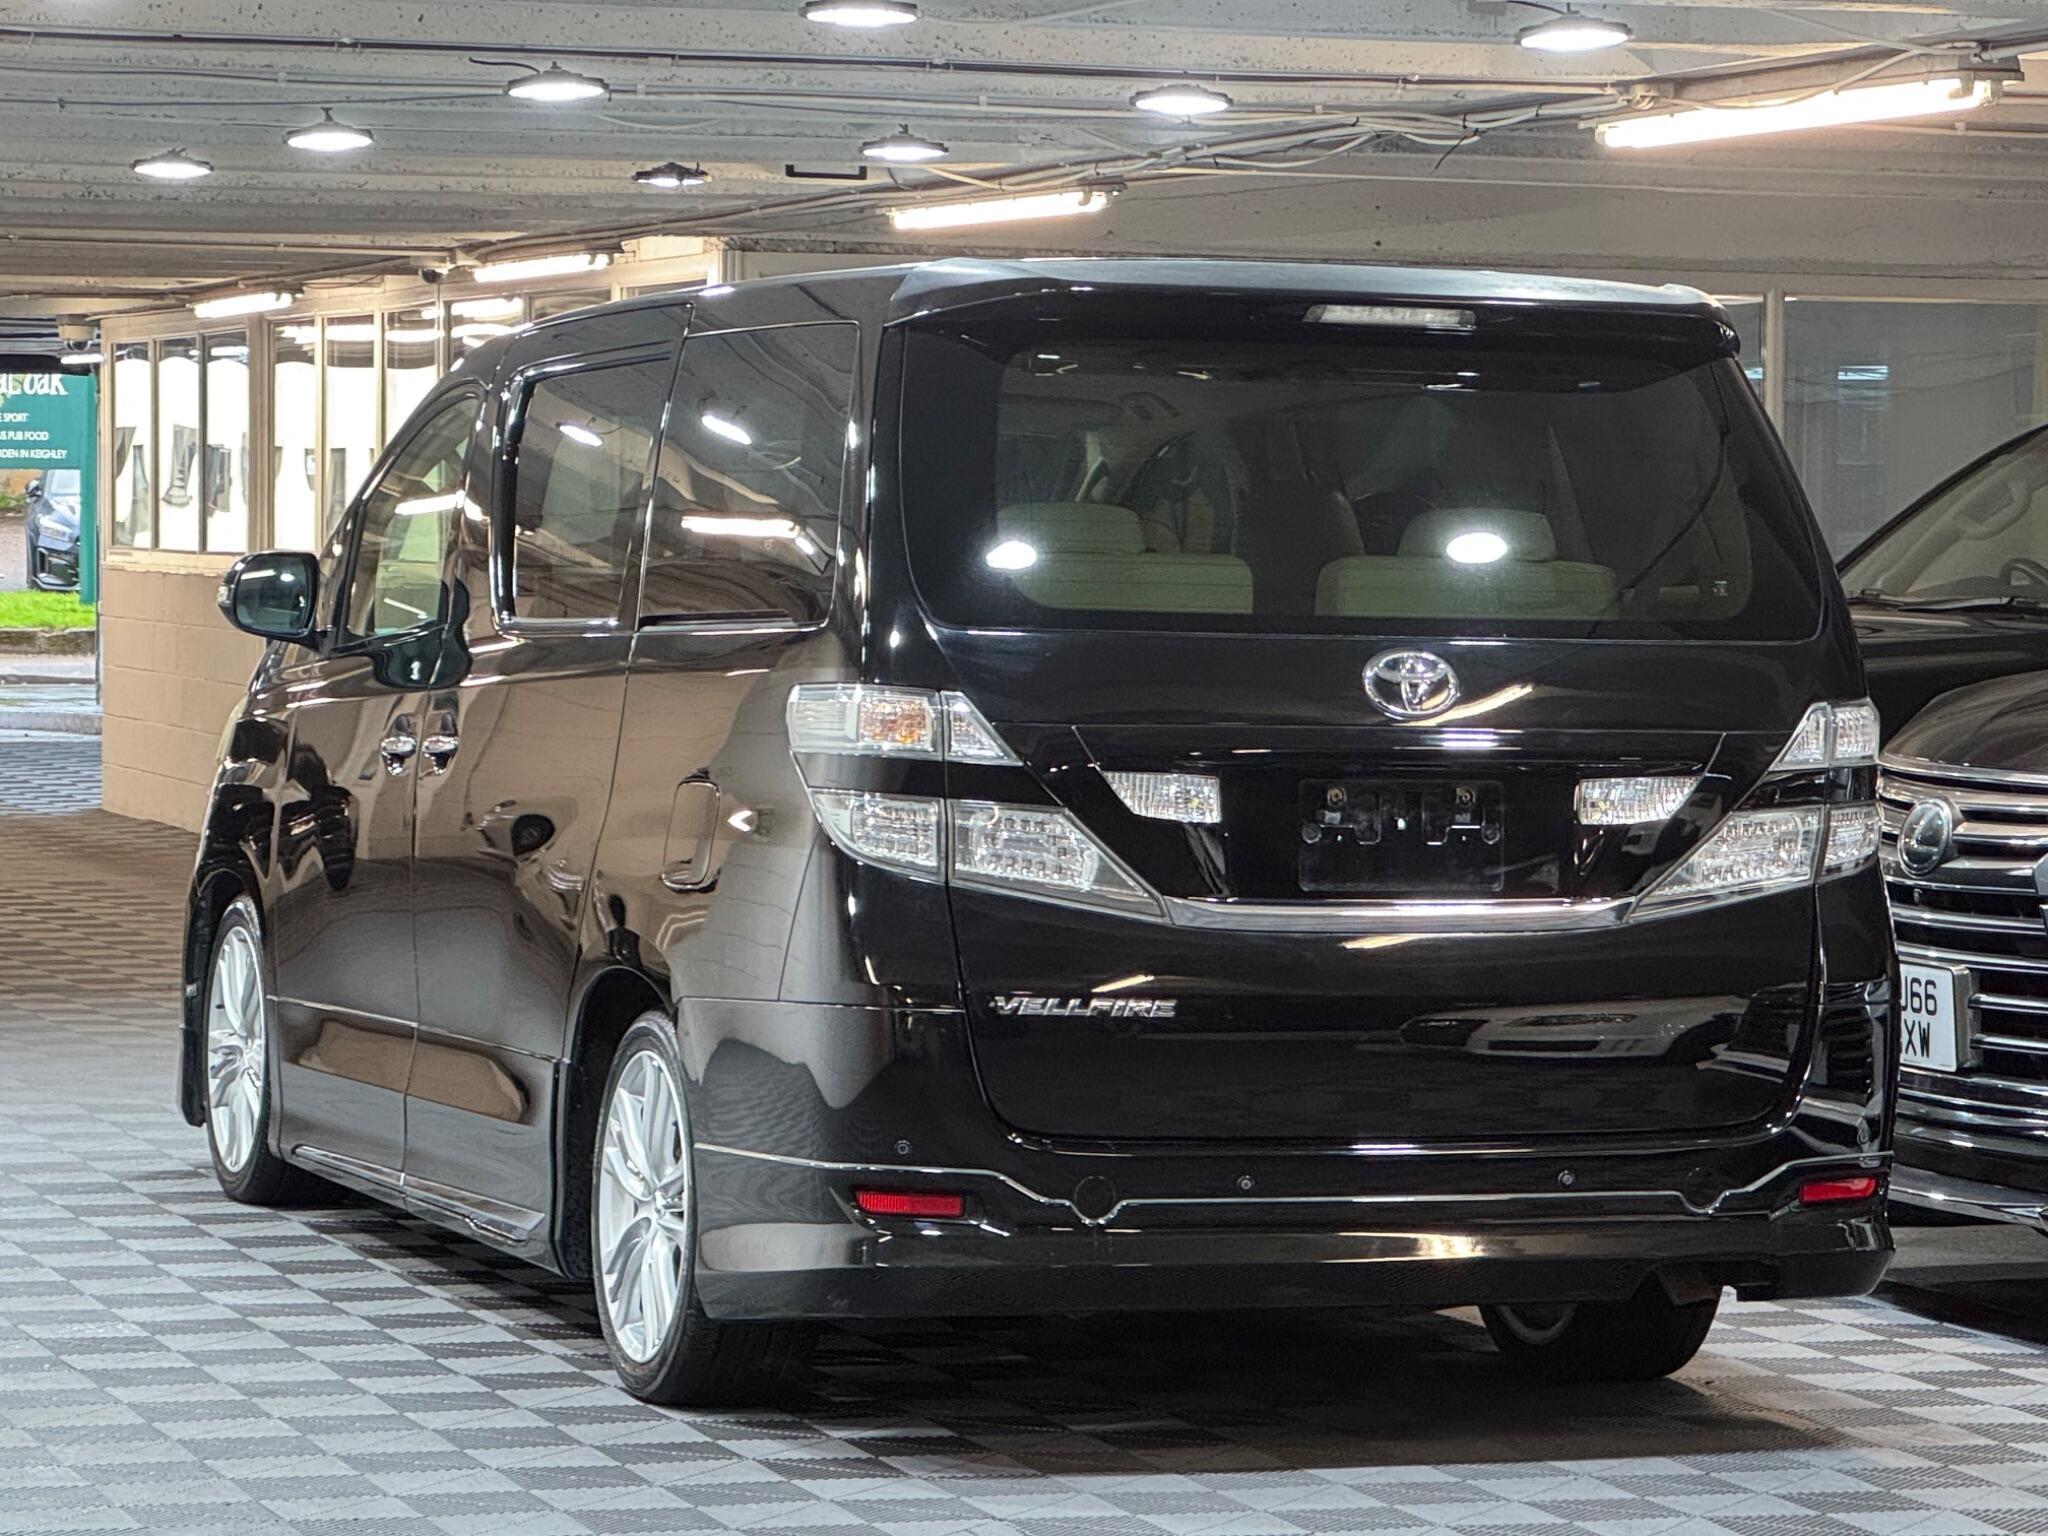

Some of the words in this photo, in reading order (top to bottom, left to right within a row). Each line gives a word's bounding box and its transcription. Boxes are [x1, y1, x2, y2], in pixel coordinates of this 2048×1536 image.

[3, 412, 29, 422] SPORT
[8, 431, 23, 441] PUB
[24, 431, 49, 441] FOOD
[20, 449, 29, 458] IN
[31, 449, 67, 459] KEIGHLEY
[993, 996, 1178, 1018] VELLFIRE
[1901, 1018, 1930, 1058] XW
